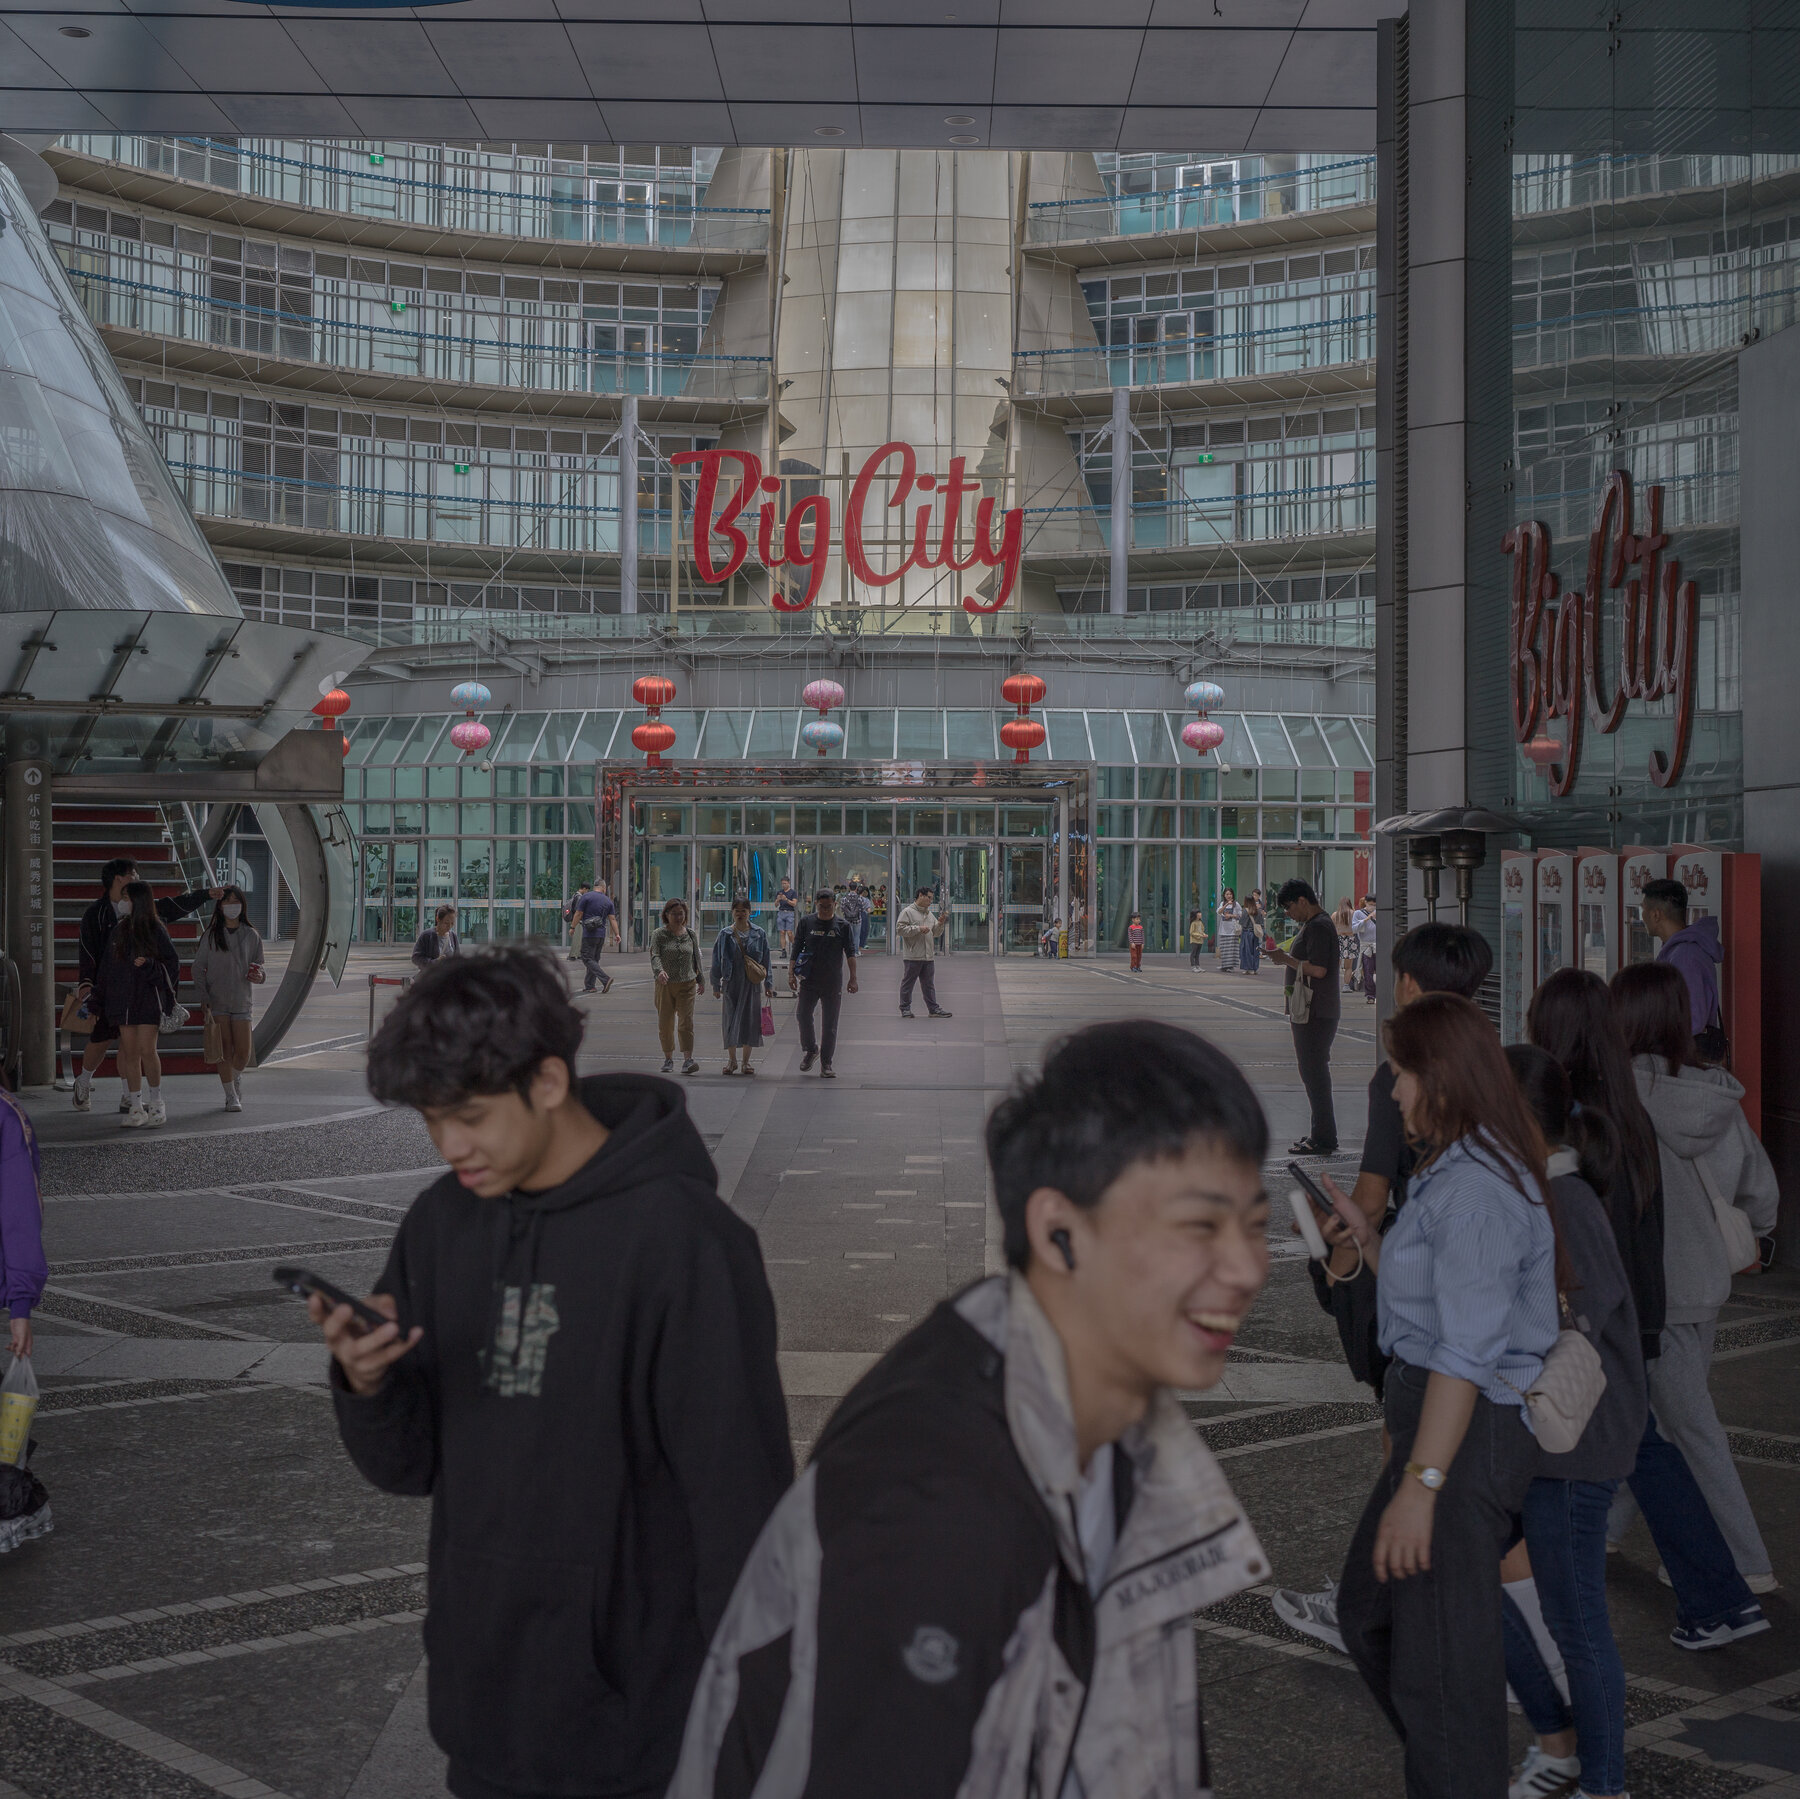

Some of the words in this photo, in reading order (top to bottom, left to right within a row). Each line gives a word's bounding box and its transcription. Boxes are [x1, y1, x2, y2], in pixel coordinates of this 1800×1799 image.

[670, 448, 831, 612] Big
[844, 441, 1024, 614] City
[1501, 520, 1583, 797] Big
[1582, 469, 1697, 788] City
[27, 793, 41, 804] 4F
[29, 805, 41, 845] 小吃街
[29, 857, 42, 910] 威秀影城
[30, 922, 43, 933] 5F
